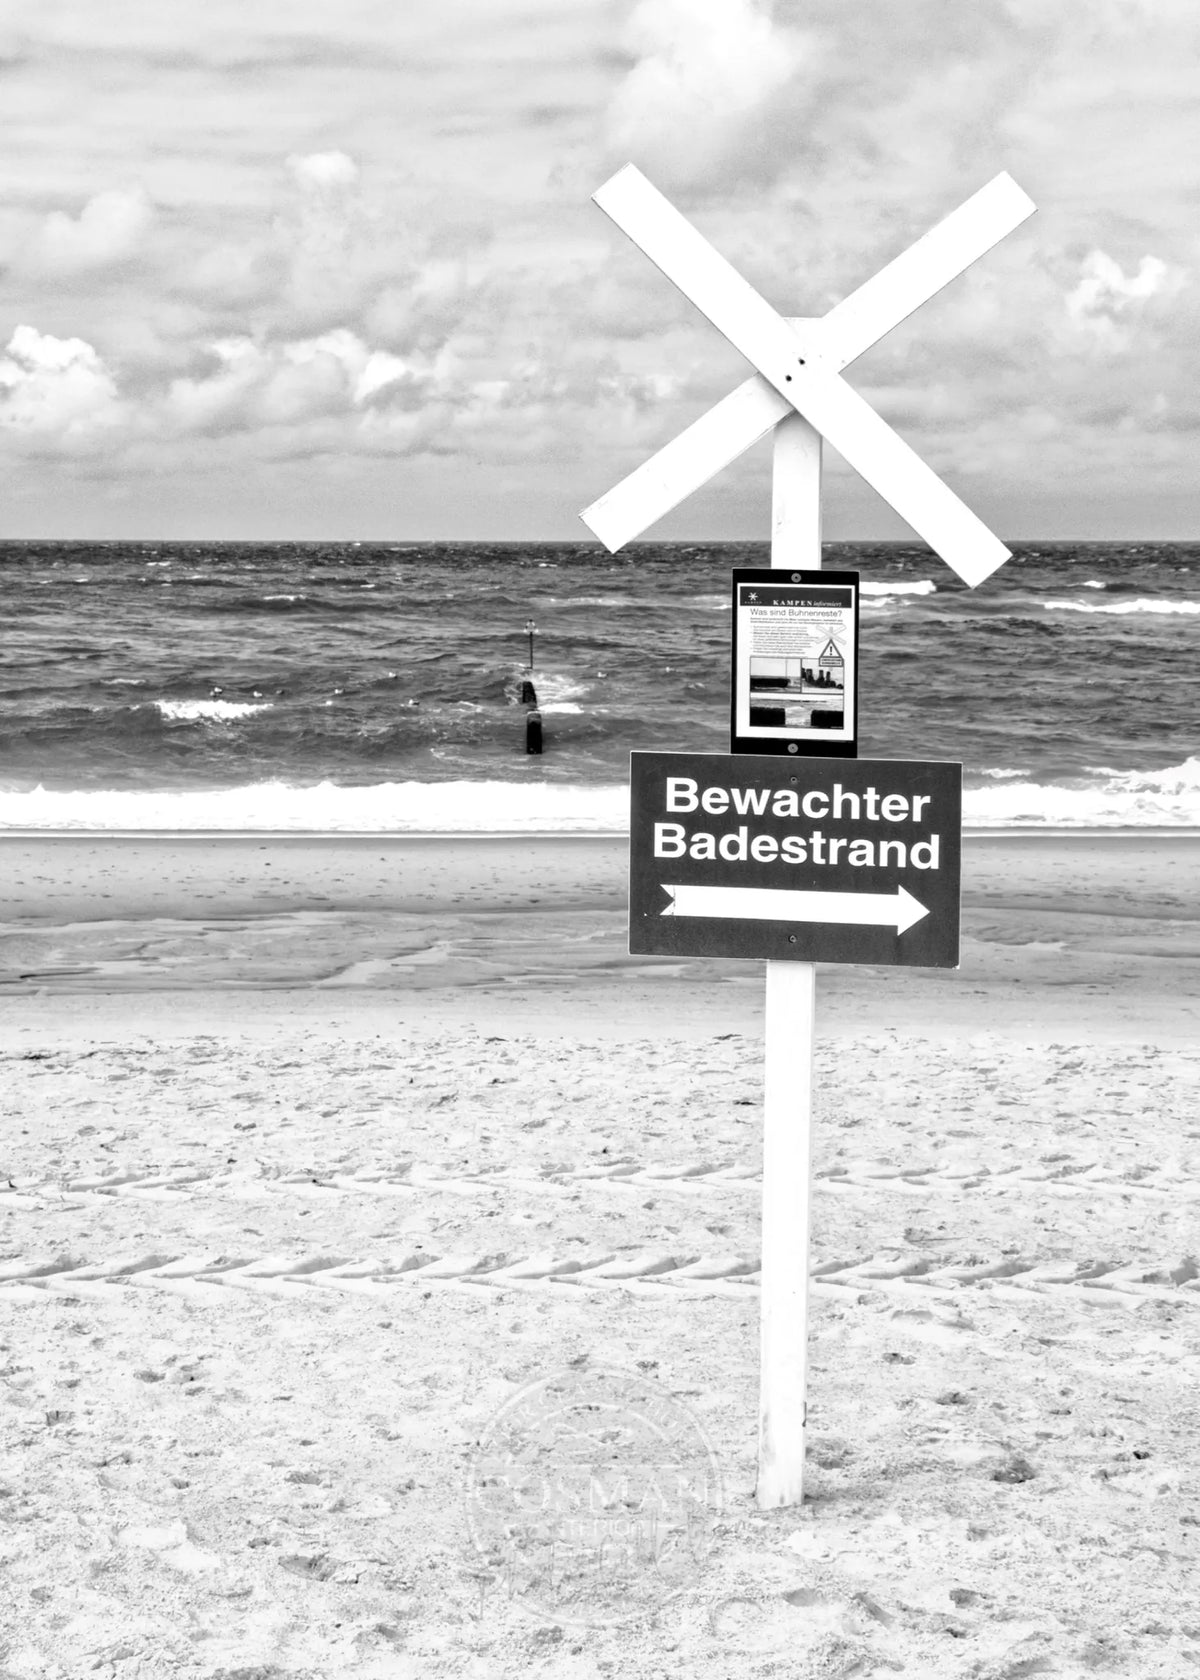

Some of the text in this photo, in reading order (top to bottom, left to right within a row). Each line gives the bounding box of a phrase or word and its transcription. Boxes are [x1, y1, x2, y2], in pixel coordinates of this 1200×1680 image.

[750, 608, 843, 618] Was sind Buhnenreste?
[813, 600, 842, 608] informiert
[666, 777, 931, 823] Bewachter
[653, 822, 940, 870] Badestrand
